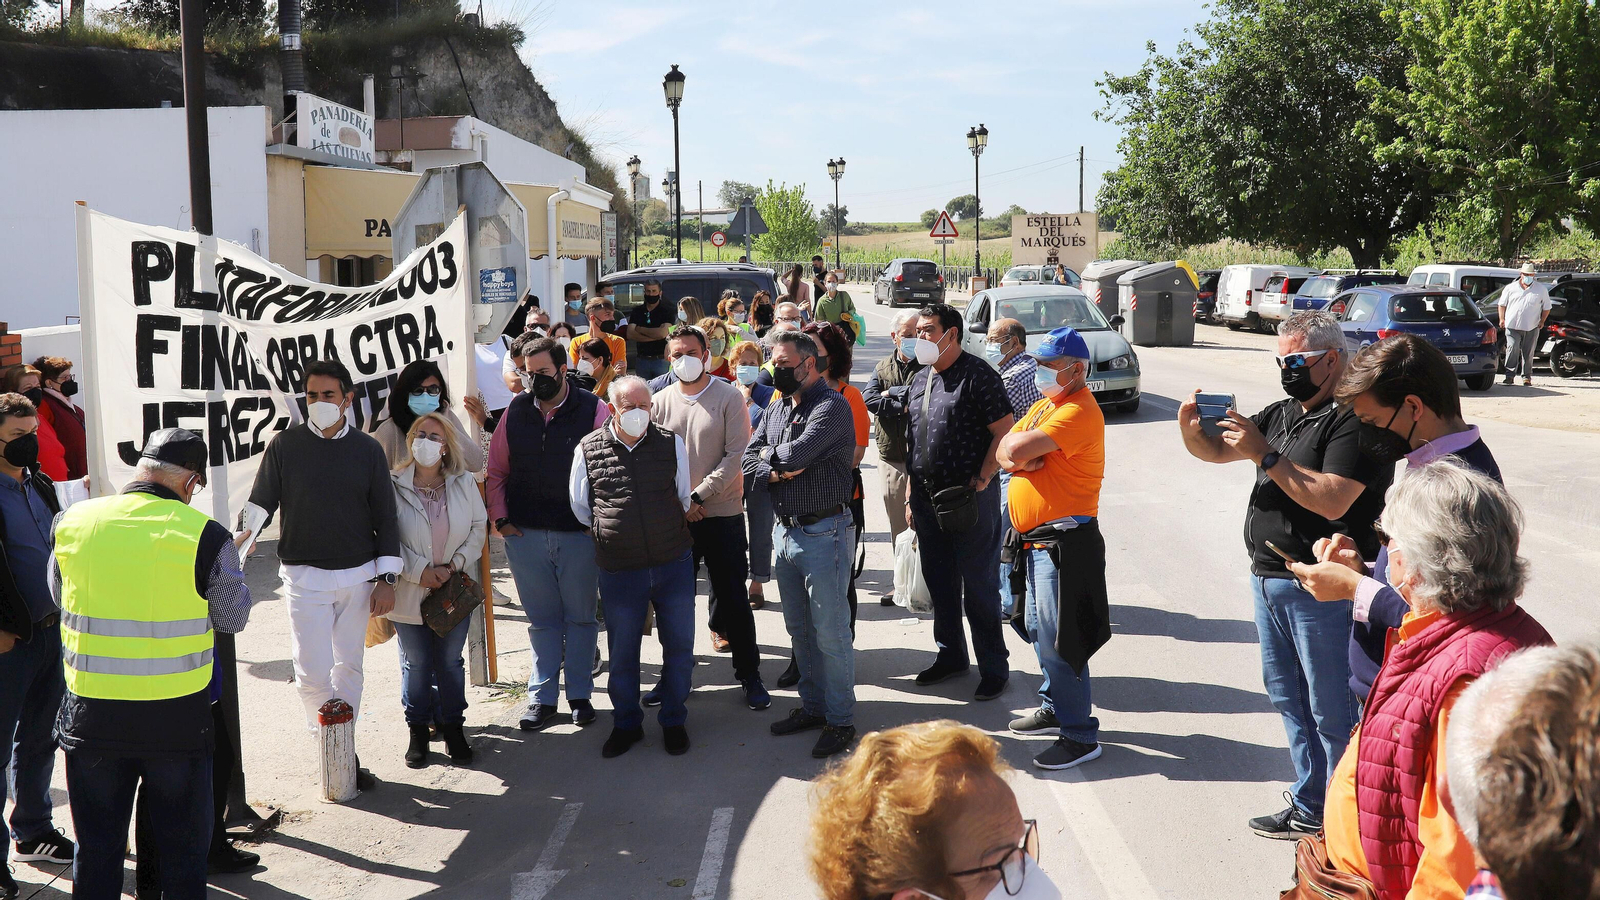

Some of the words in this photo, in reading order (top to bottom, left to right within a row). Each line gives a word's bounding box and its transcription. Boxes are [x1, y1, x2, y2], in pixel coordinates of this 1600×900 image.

[310, 106, 373, 141] PANADERÍA
[321, 122, 331, 138] de
[1027, 216, 1082, 227] ESTELLA
[1039, 226, 1064, 237] DEL
[1021, 232, 1086, 249] MARQUÉS
[136, 313, 271, 391] FINAL
[349, 305, 454, 375] CTRA.
